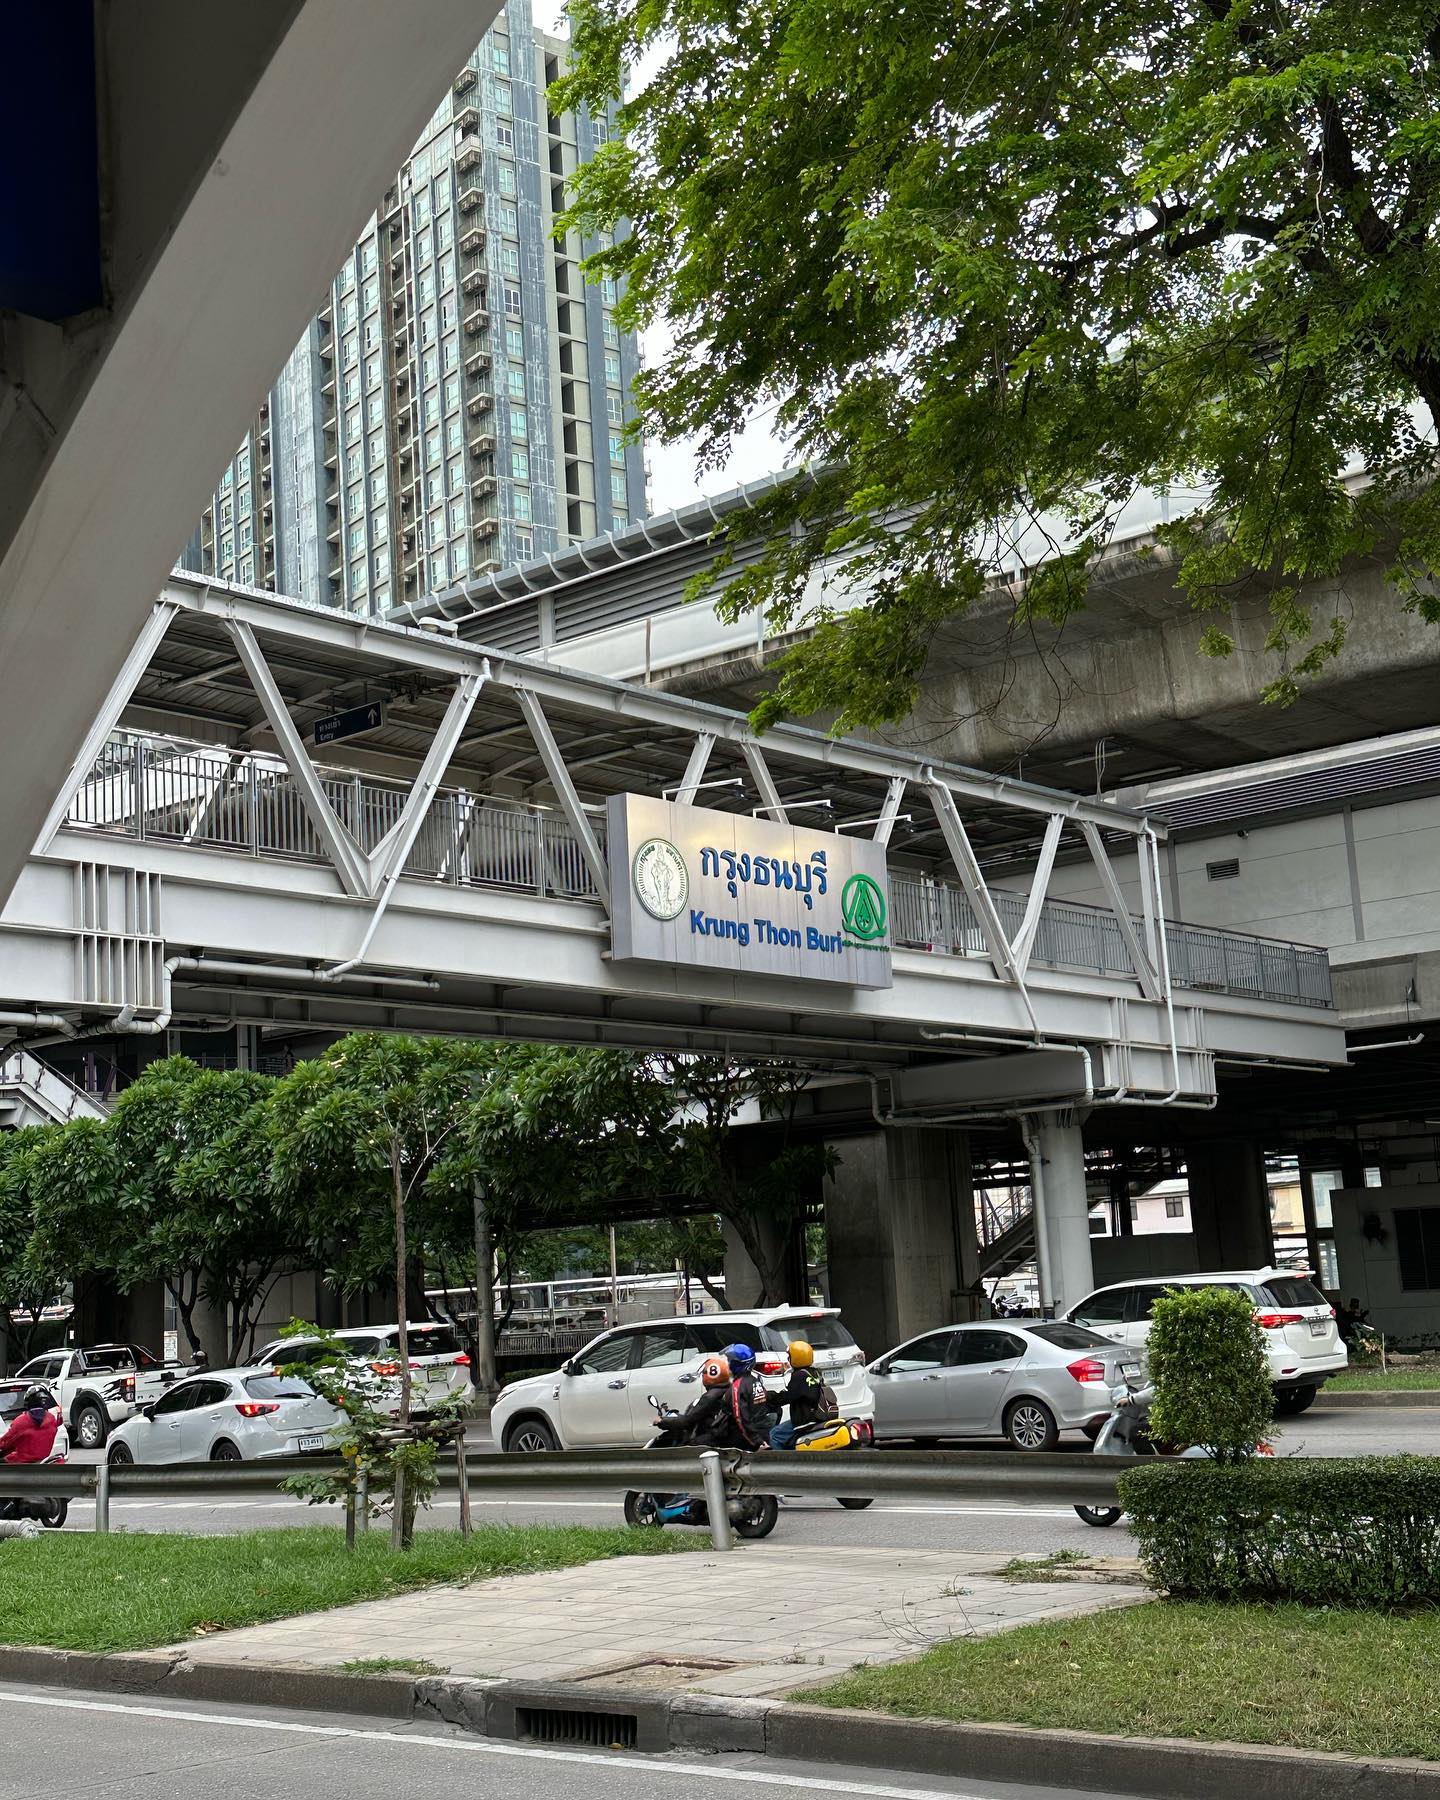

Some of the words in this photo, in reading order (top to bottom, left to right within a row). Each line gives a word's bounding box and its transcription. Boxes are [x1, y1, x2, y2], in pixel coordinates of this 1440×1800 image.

[699, 847, 828, 910] กรุงธนบุรี
[690, 910, 750, 946] Krung
[753, 919, 802, 948] Thon
[806, 926, 843, 953] Buri
[692, 1302, 701, 1315] P
[709, 1365, 718, 1376] 8
